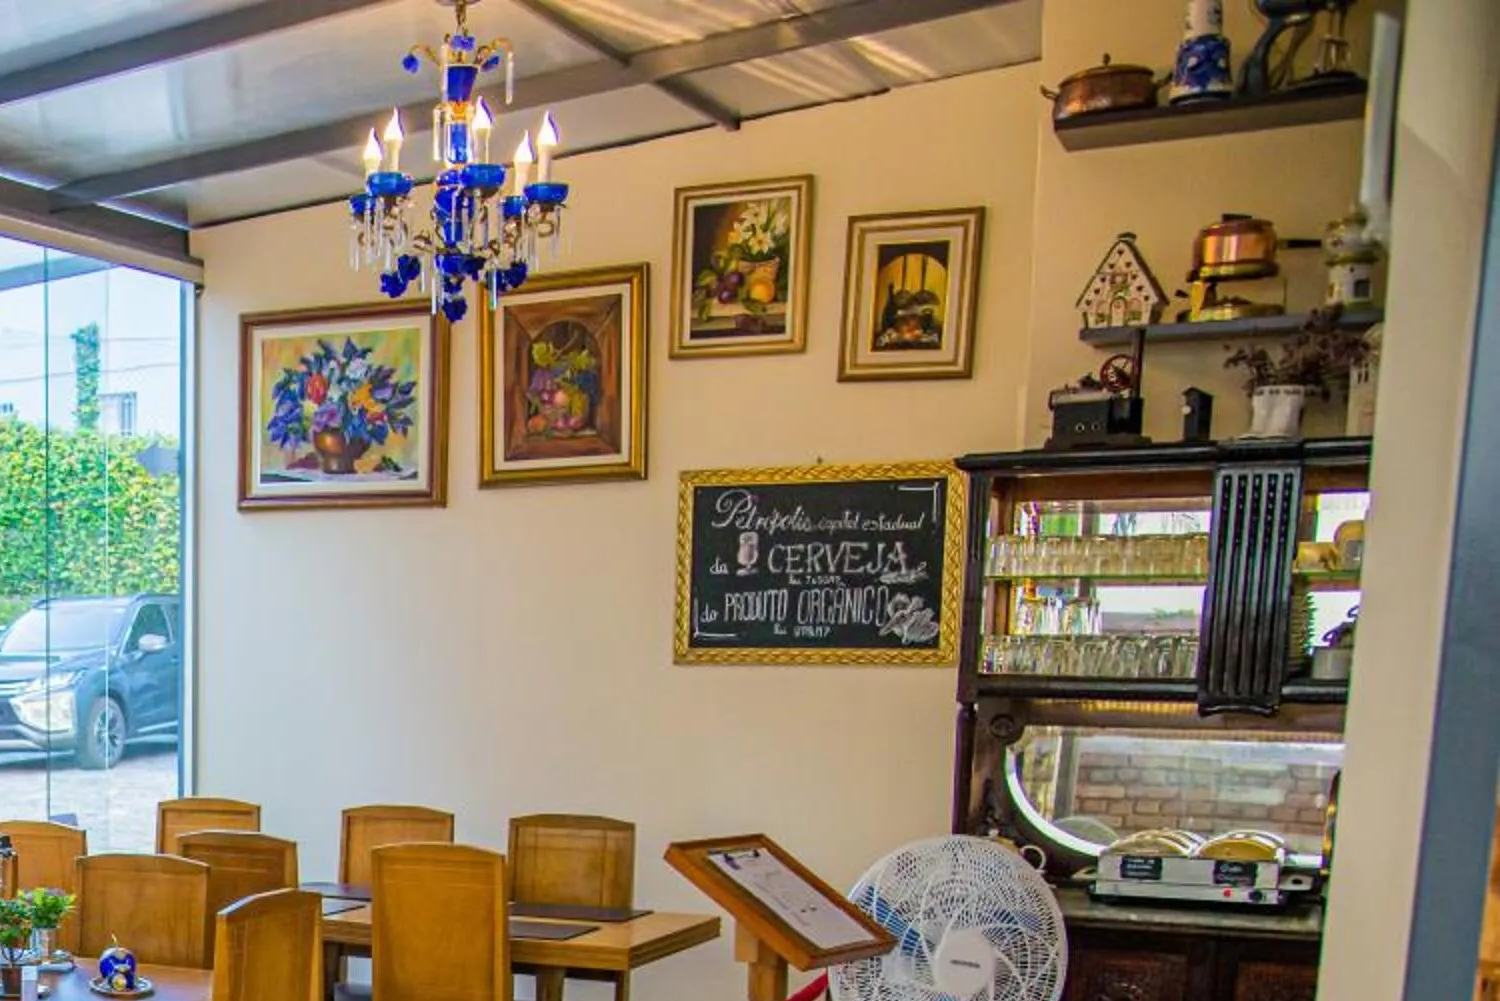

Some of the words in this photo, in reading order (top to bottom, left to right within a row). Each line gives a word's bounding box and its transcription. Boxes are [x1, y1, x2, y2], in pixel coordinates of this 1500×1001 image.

[710, 556, 729, 575] da
[768, 541, 908, 575] CERVEJA
[700, 604, 719, 622] do
[724, 588, 788, 622] PRODUTO
